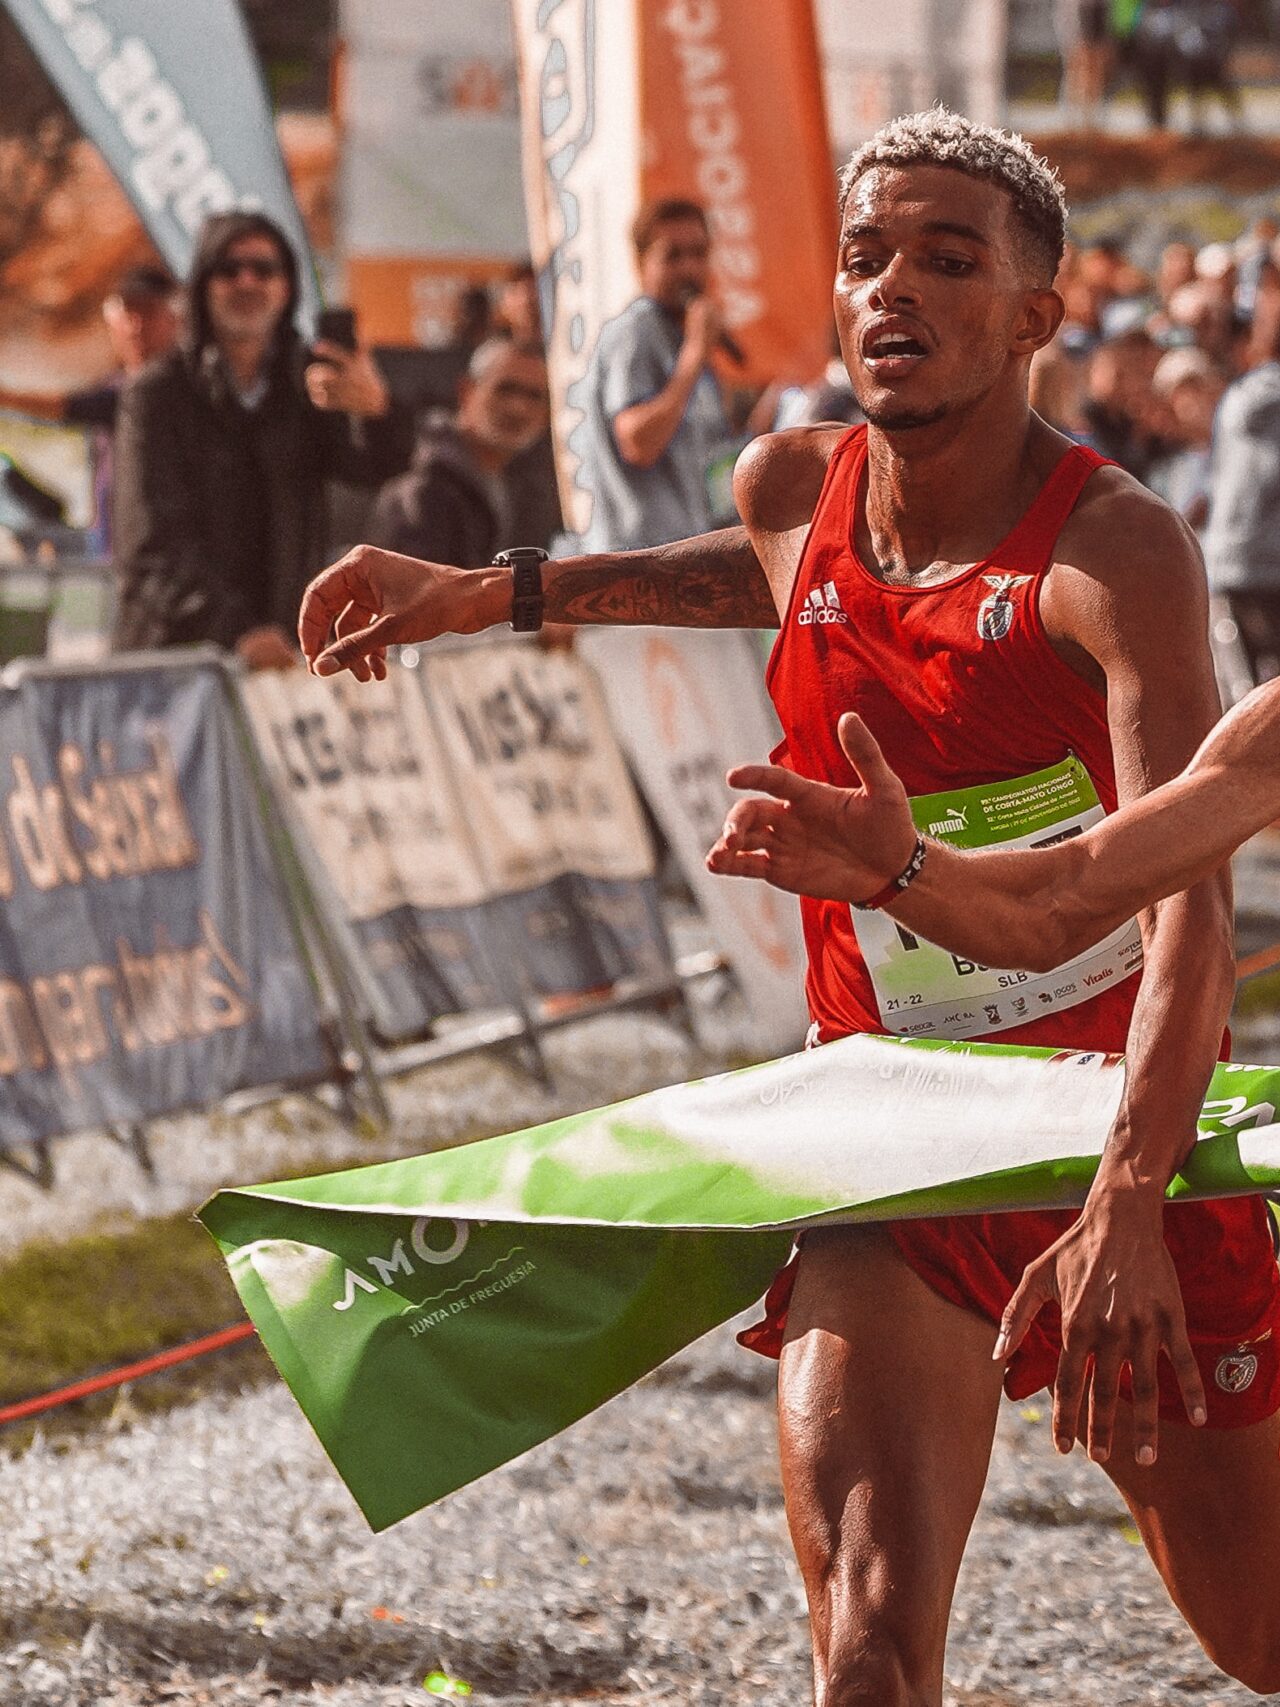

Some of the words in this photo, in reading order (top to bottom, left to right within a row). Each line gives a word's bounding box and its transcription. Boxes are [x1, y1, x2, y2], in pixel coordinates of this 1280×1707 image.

[798, 607, 849, 626] adidas
[983, 805, 995, 813] DE
[1046, 778, 1075, 795] LONGO
[928, 818, 964, 836] PUMA
[997, 971, 1029, 988] SLB
[886, 999, 899, 1010] 21
[909, 993, 923, 1004] 22
[332, 1215, 489, 1312] AMO
[407, 1308, 450, 1338] JUNTA
[448, 1296, 471, 1316] DE
[468, 1259, 538, 1305] FREGUESIA
